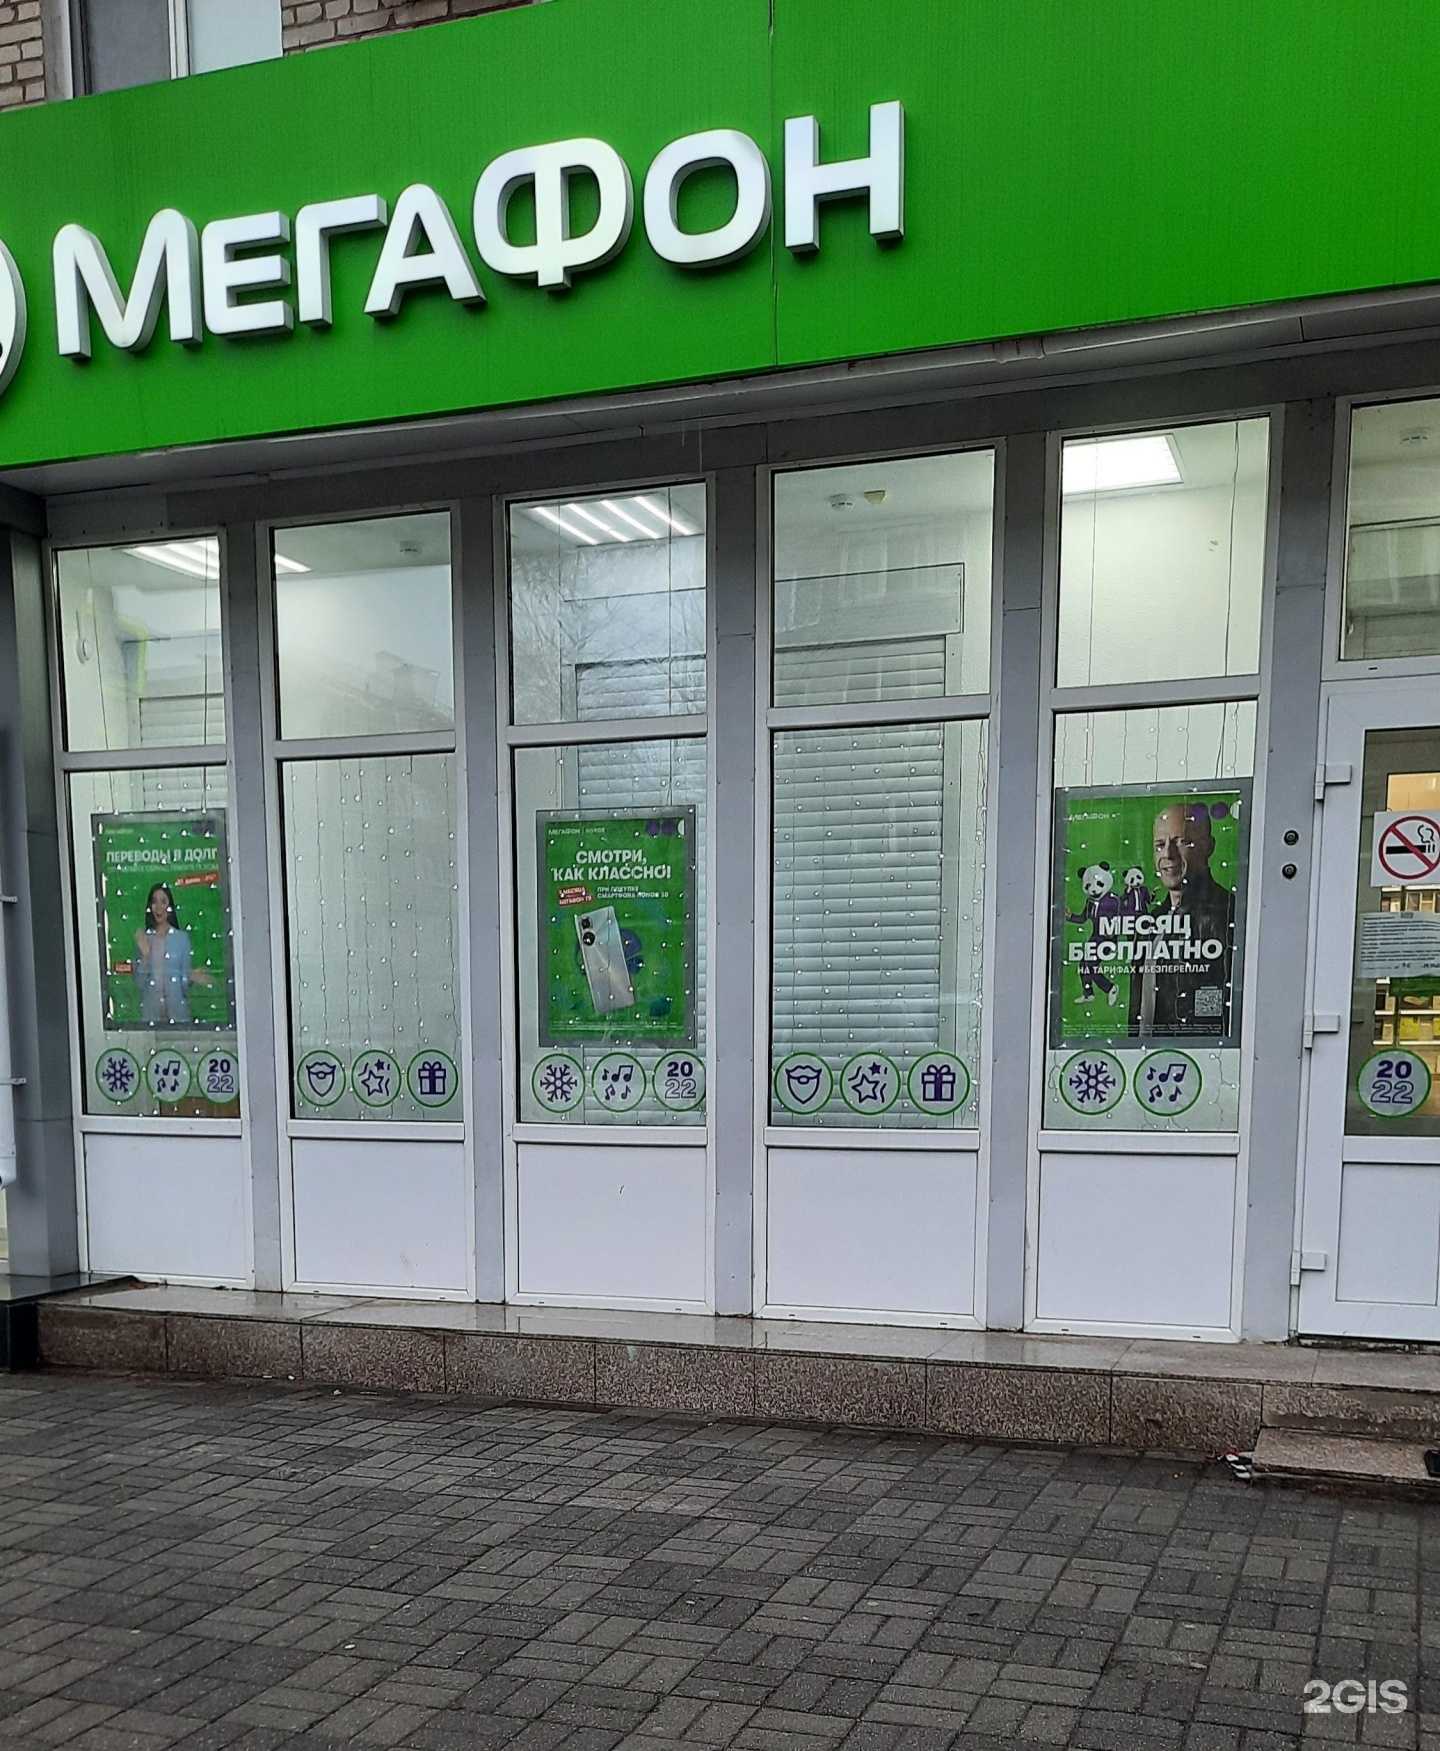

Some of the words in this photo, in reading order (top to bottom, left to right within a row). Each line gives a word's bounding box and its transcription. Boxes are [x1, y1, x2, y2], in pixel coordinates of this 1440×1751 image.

[52, 100, 906, 360] МЕГАФОН
[106, 849, 171, 862] ПЕРЕВОДЫ
[184, 848, 218, 861] ДОЛГ
[576, 849, 647, 865] СМОТРИ,
[553, 868, 584, 881] КАК
[588, 865, 671, 880] КЛАССНО!
[1099, 914, 1192, 939] МЕСЯЦ
[1068, 939, 1223, 961] БЕСПЛАТНО
[1077, 966, 1090, 975] НА
[1093, 965, 1136, 975] ТАРИФАХ
[209, 1058, 231, 1074] 20
[667, 1061, 693, 1077] 20
[1376, 1060, 1412, 1079] 20
[207, 1074, 234, 1093] 22
[664, 1078, 697, 1099] 22
[1370, 1080, 1415, 1105] 22
